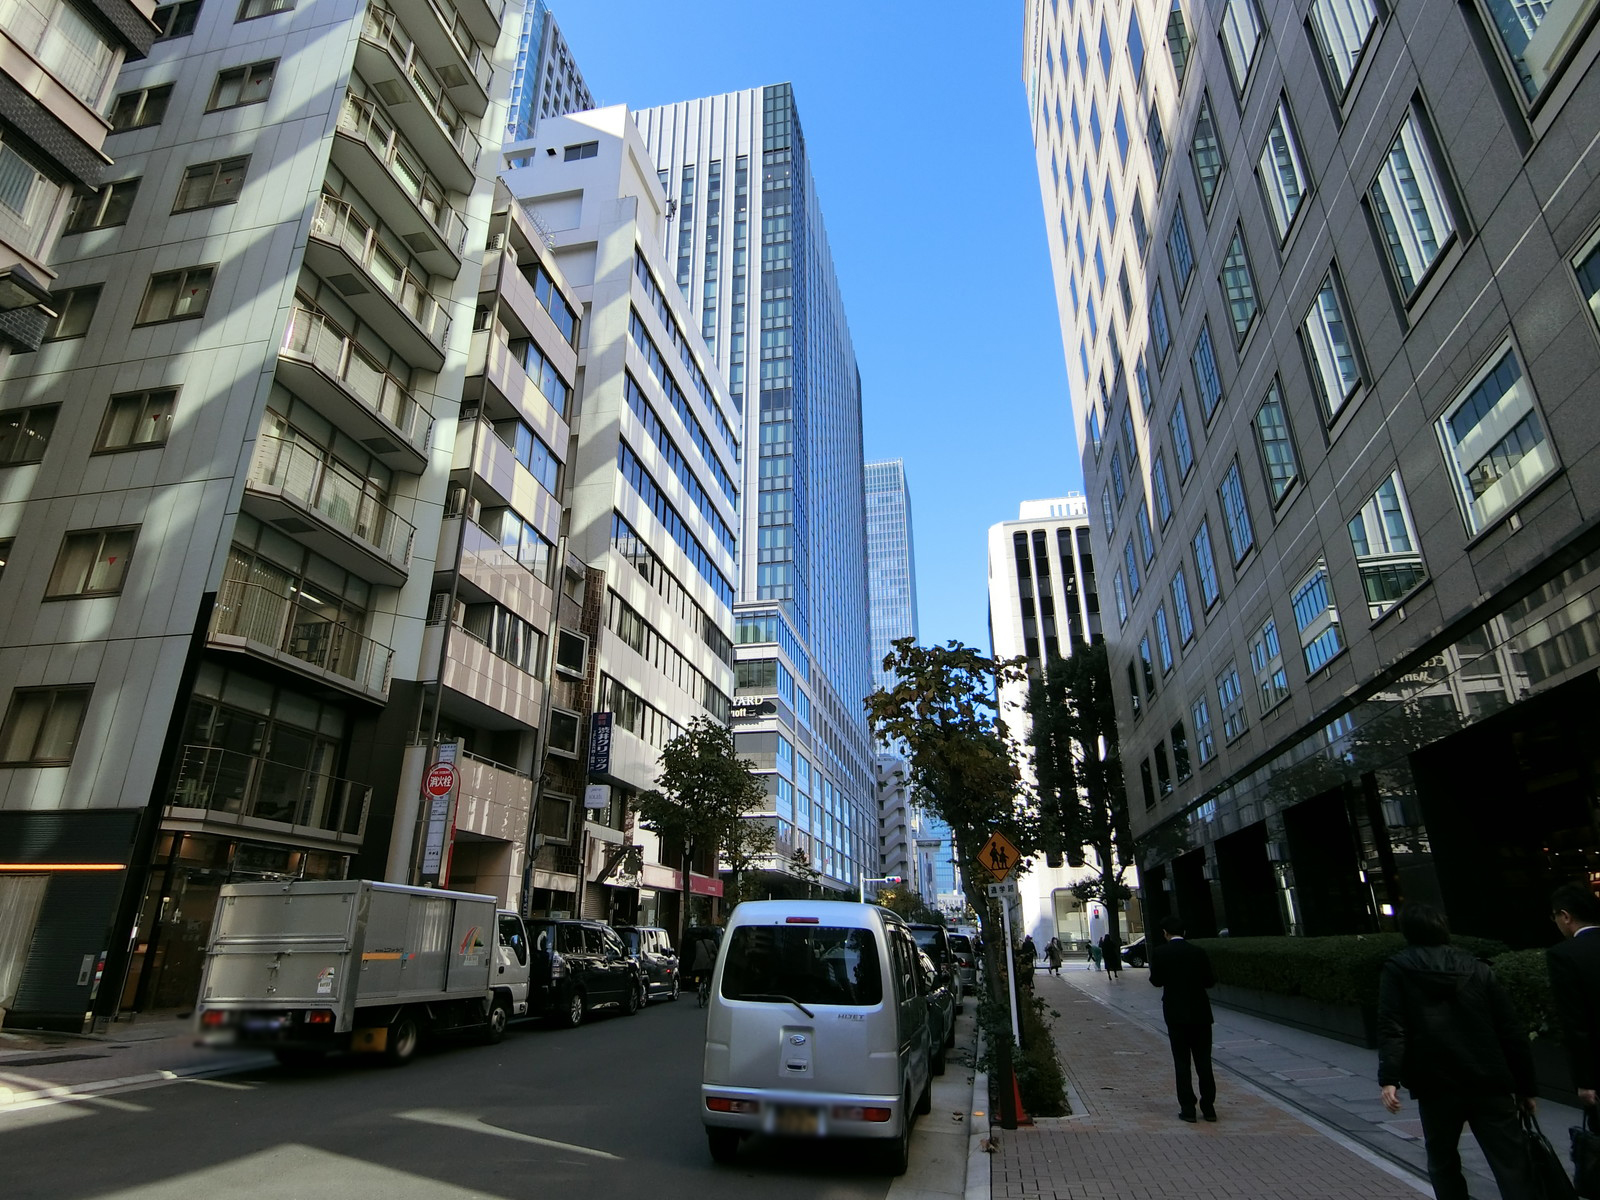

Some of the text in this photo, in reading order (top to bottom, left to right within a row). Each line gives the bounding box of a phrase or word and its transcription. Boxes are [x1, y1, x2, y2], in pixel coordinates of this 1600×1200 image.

[429, 775, 452, 788] 消火栓
[990, 884, 1015, 894] 通学路
